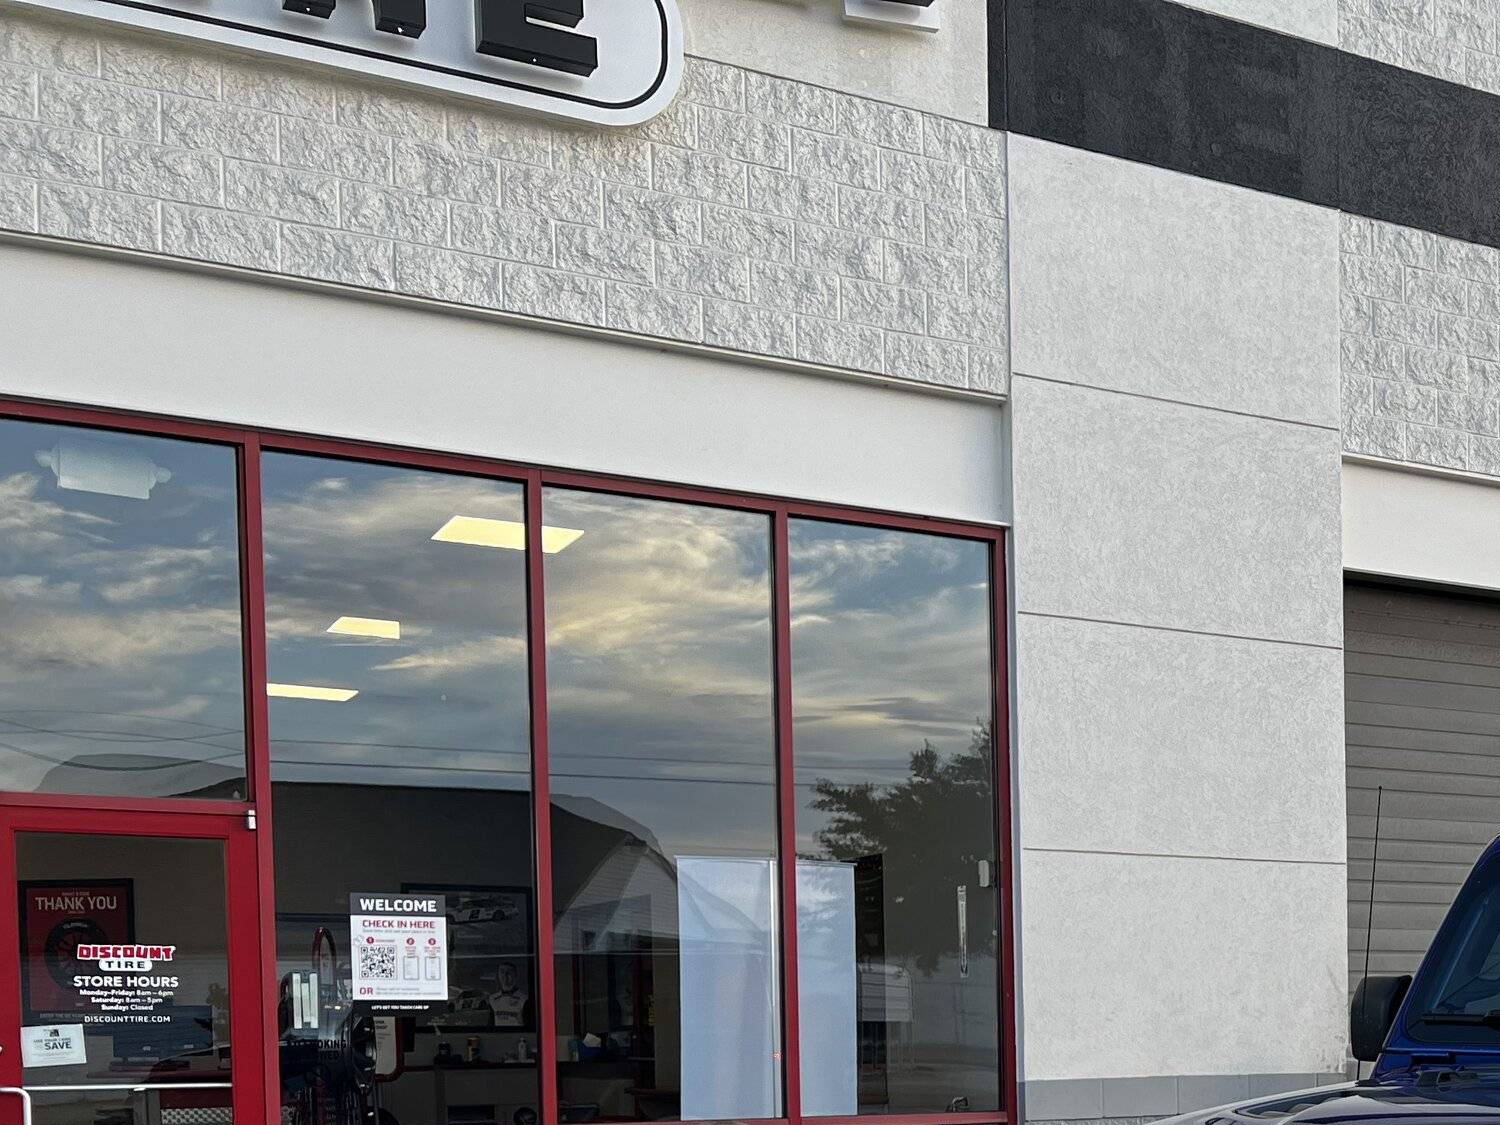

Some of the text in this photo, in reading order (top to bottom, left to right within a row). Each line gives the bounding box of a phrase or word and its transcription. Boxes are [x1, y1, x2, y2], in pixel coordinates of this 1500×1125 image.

[34, 896, 117, 910] THANK YOU
[359, 898, 437, 912] WELCOME
[362, 920, 394, 928] CHECK
[410, 921, 435, 929] HERE
[77, 944, 175, 960] DISCOUNT
[73, 976, 179, 987] STORE HOURS
[359, 987, 374, 995] OR
[84, 1015, 171, 1023] DISCOUNTTIRE.COM
[45, 1041, 72, 1050] SAVE
